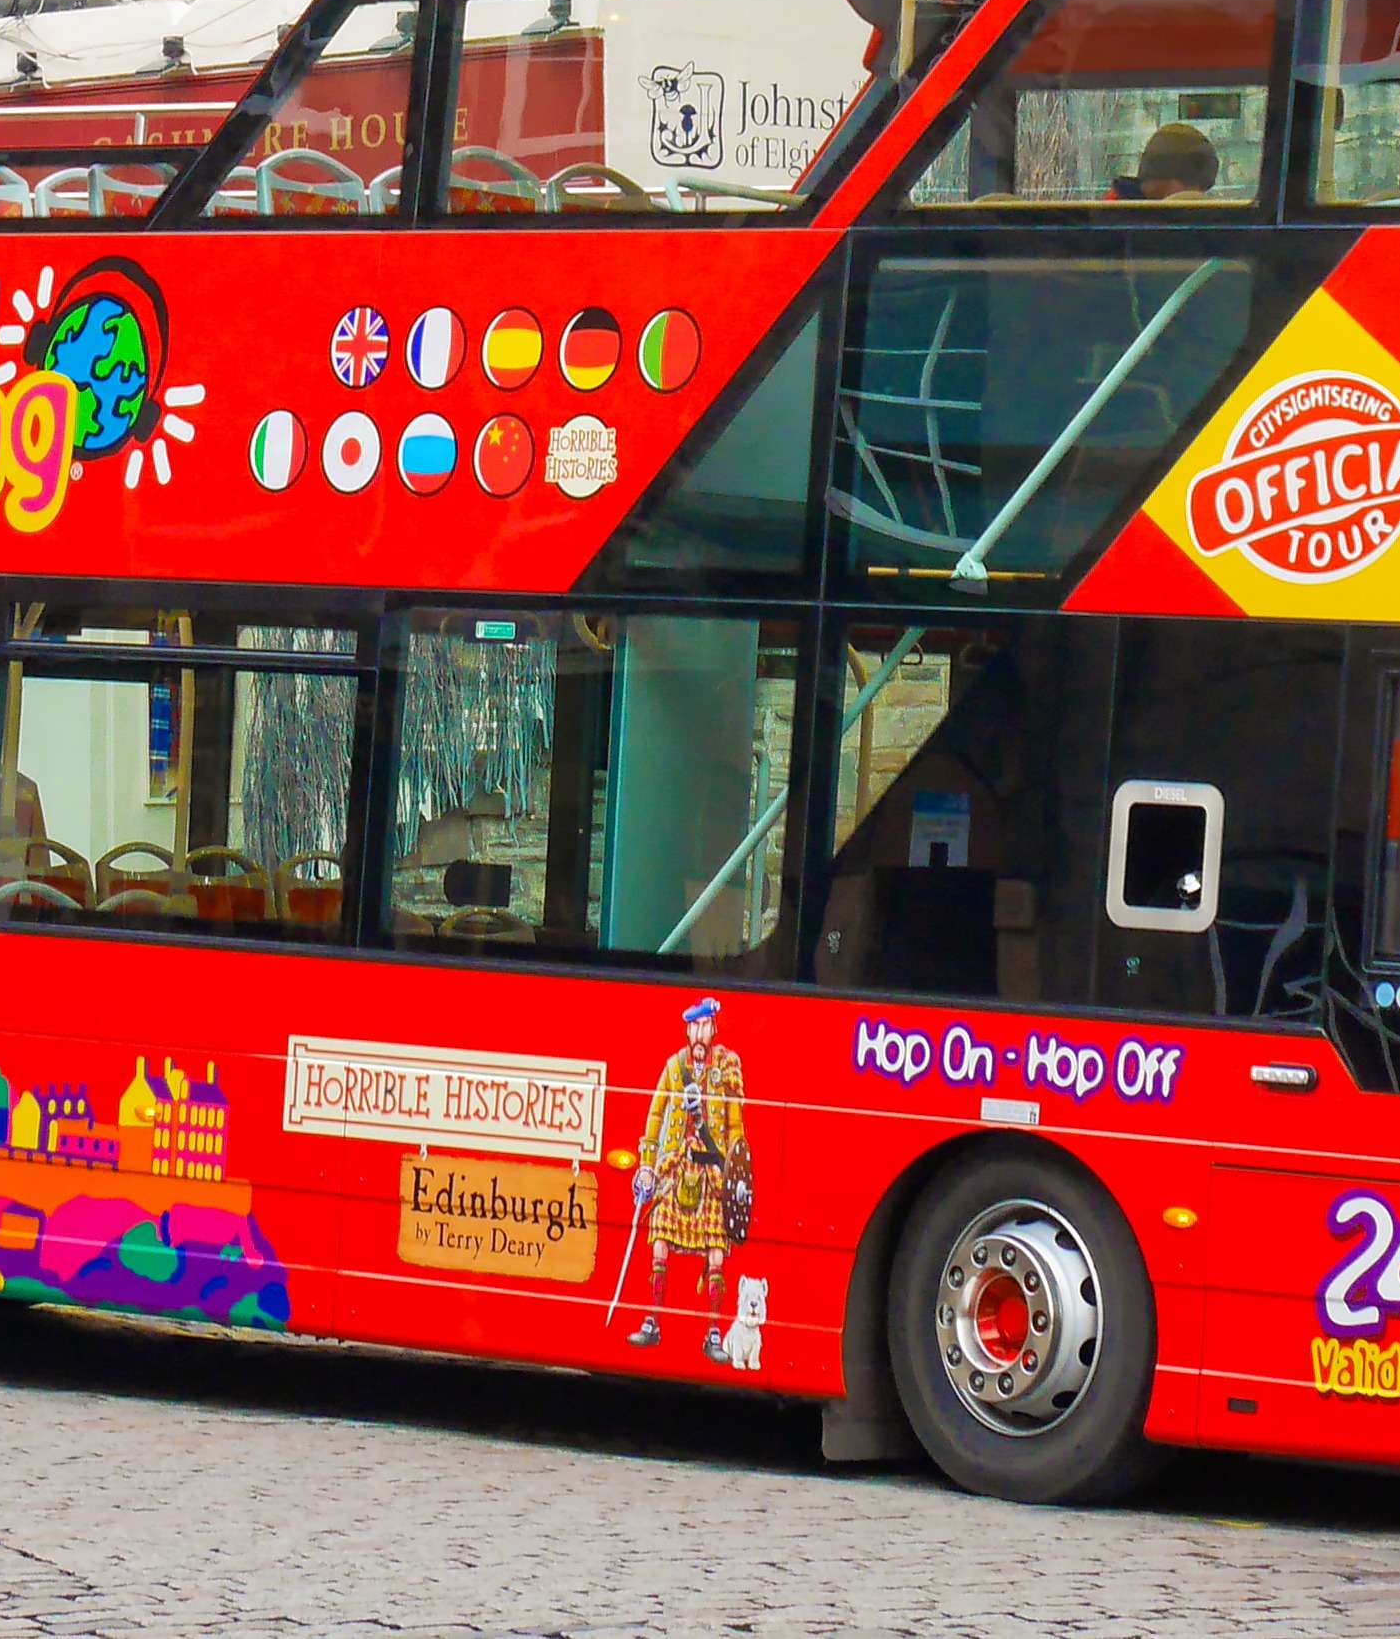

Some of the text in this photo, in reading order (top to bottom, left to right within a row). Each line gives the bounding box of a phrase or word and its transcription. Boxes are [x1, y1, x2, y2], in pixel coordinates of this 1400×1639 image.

[328, 107, 468, 152] HOUE
[735, 136, 818, 178] of Elgi
[1249, 384, 1394, 449] CITYSIGHTSEEING
[550, 427, 617, 454] HORRIBLE
[546, 455, 618, 484] HISTORIES
[1287, 508, 1394, 569] TOUR
[1153, 786, 1188, 801] DIESEL
[856, 1021, 1182, 1098] Hop On Hop Off
[303, 1062, 585, 1133] HORRIBLE HISTORIES
[411, 1165, 589, 1241] Edinburgh
[414, 1221, 547, 1267] by Terry Deary
